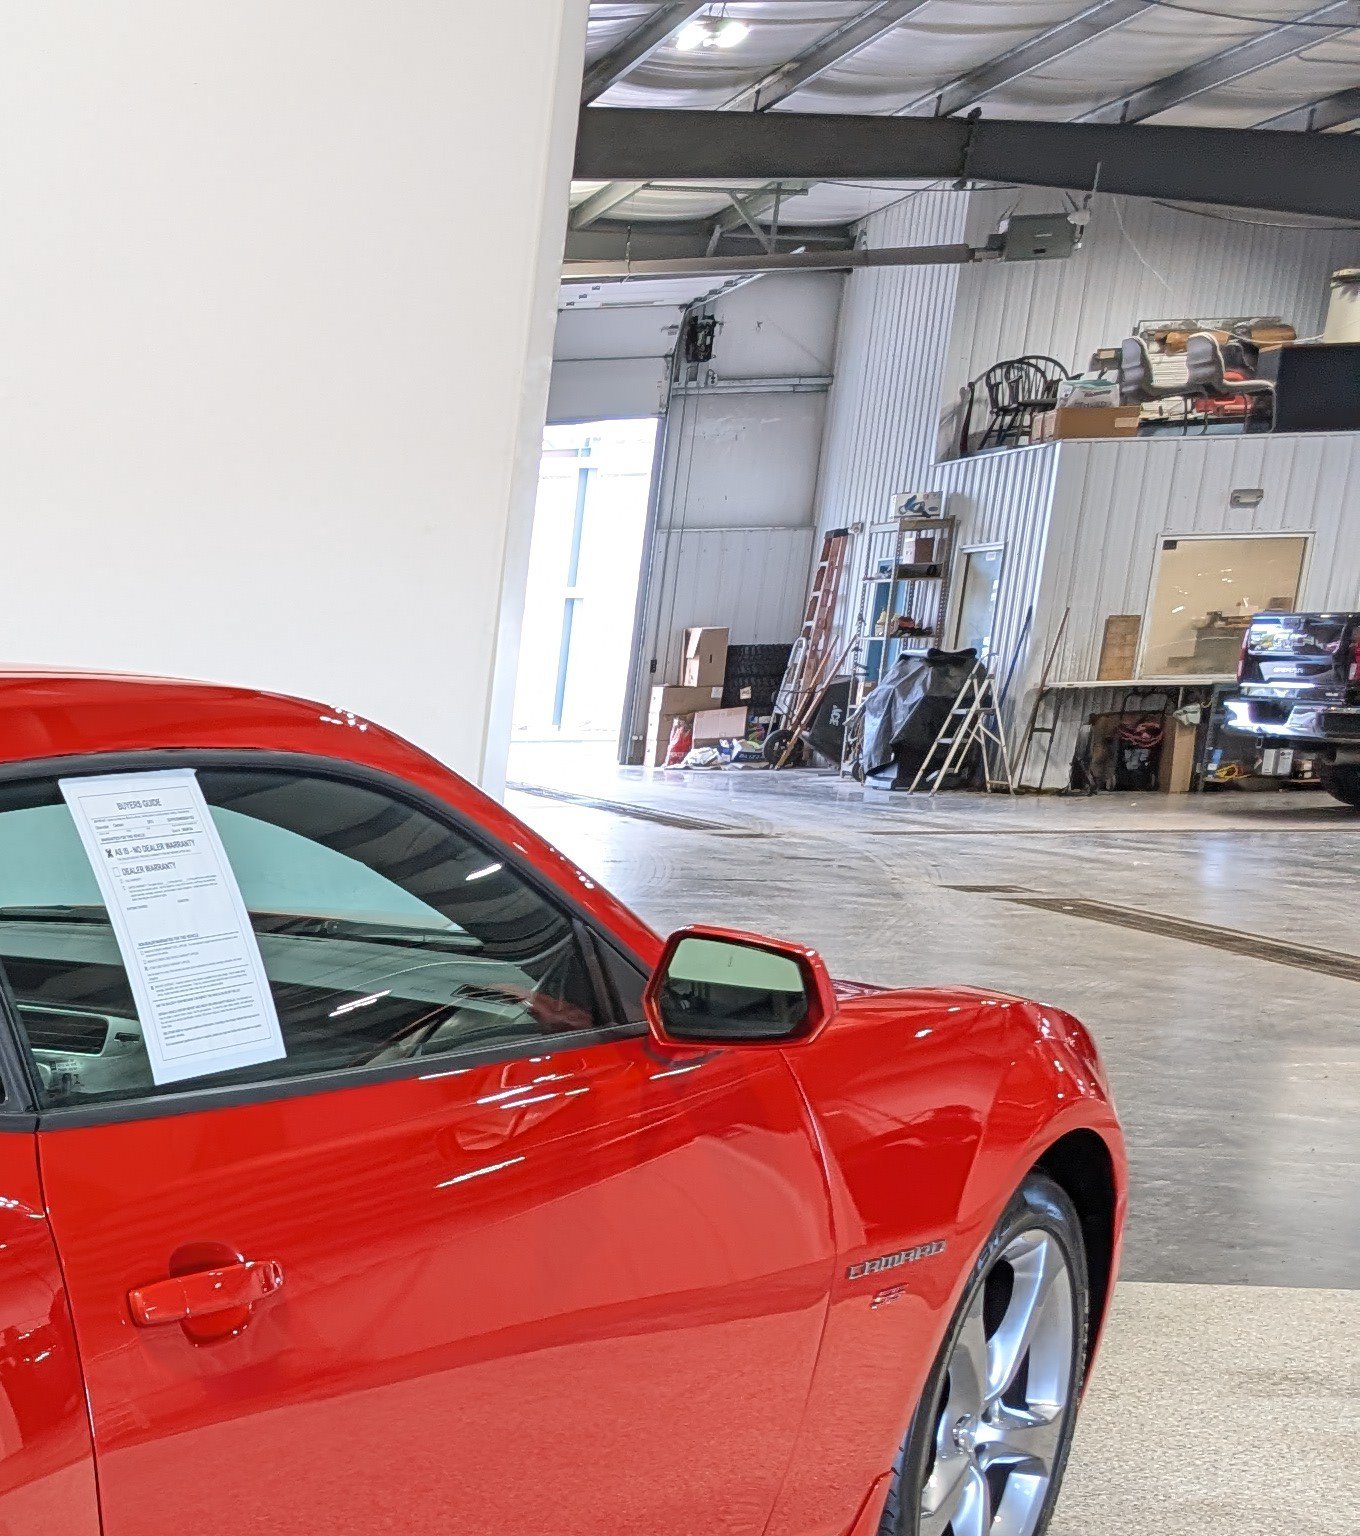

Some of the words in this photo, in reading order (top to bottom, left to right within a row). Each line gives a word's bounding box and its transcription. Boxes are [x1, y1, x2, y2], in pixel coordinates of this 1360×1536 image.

[115, 800, 143, 810] BUYERS
[141, 798, 162, 808] GUIDE
[113, 847, 123, 856] AS
[131, 845, 142, 853] NO
[141, 842, 165, 852] DEALER
[164, 838, 196, 849] WARRANTY
[120, 865, 145, 875] DEALER
[144, 861, 177, 872] WARRANTY
[847, 1239, 947, 1279] CAMARO
